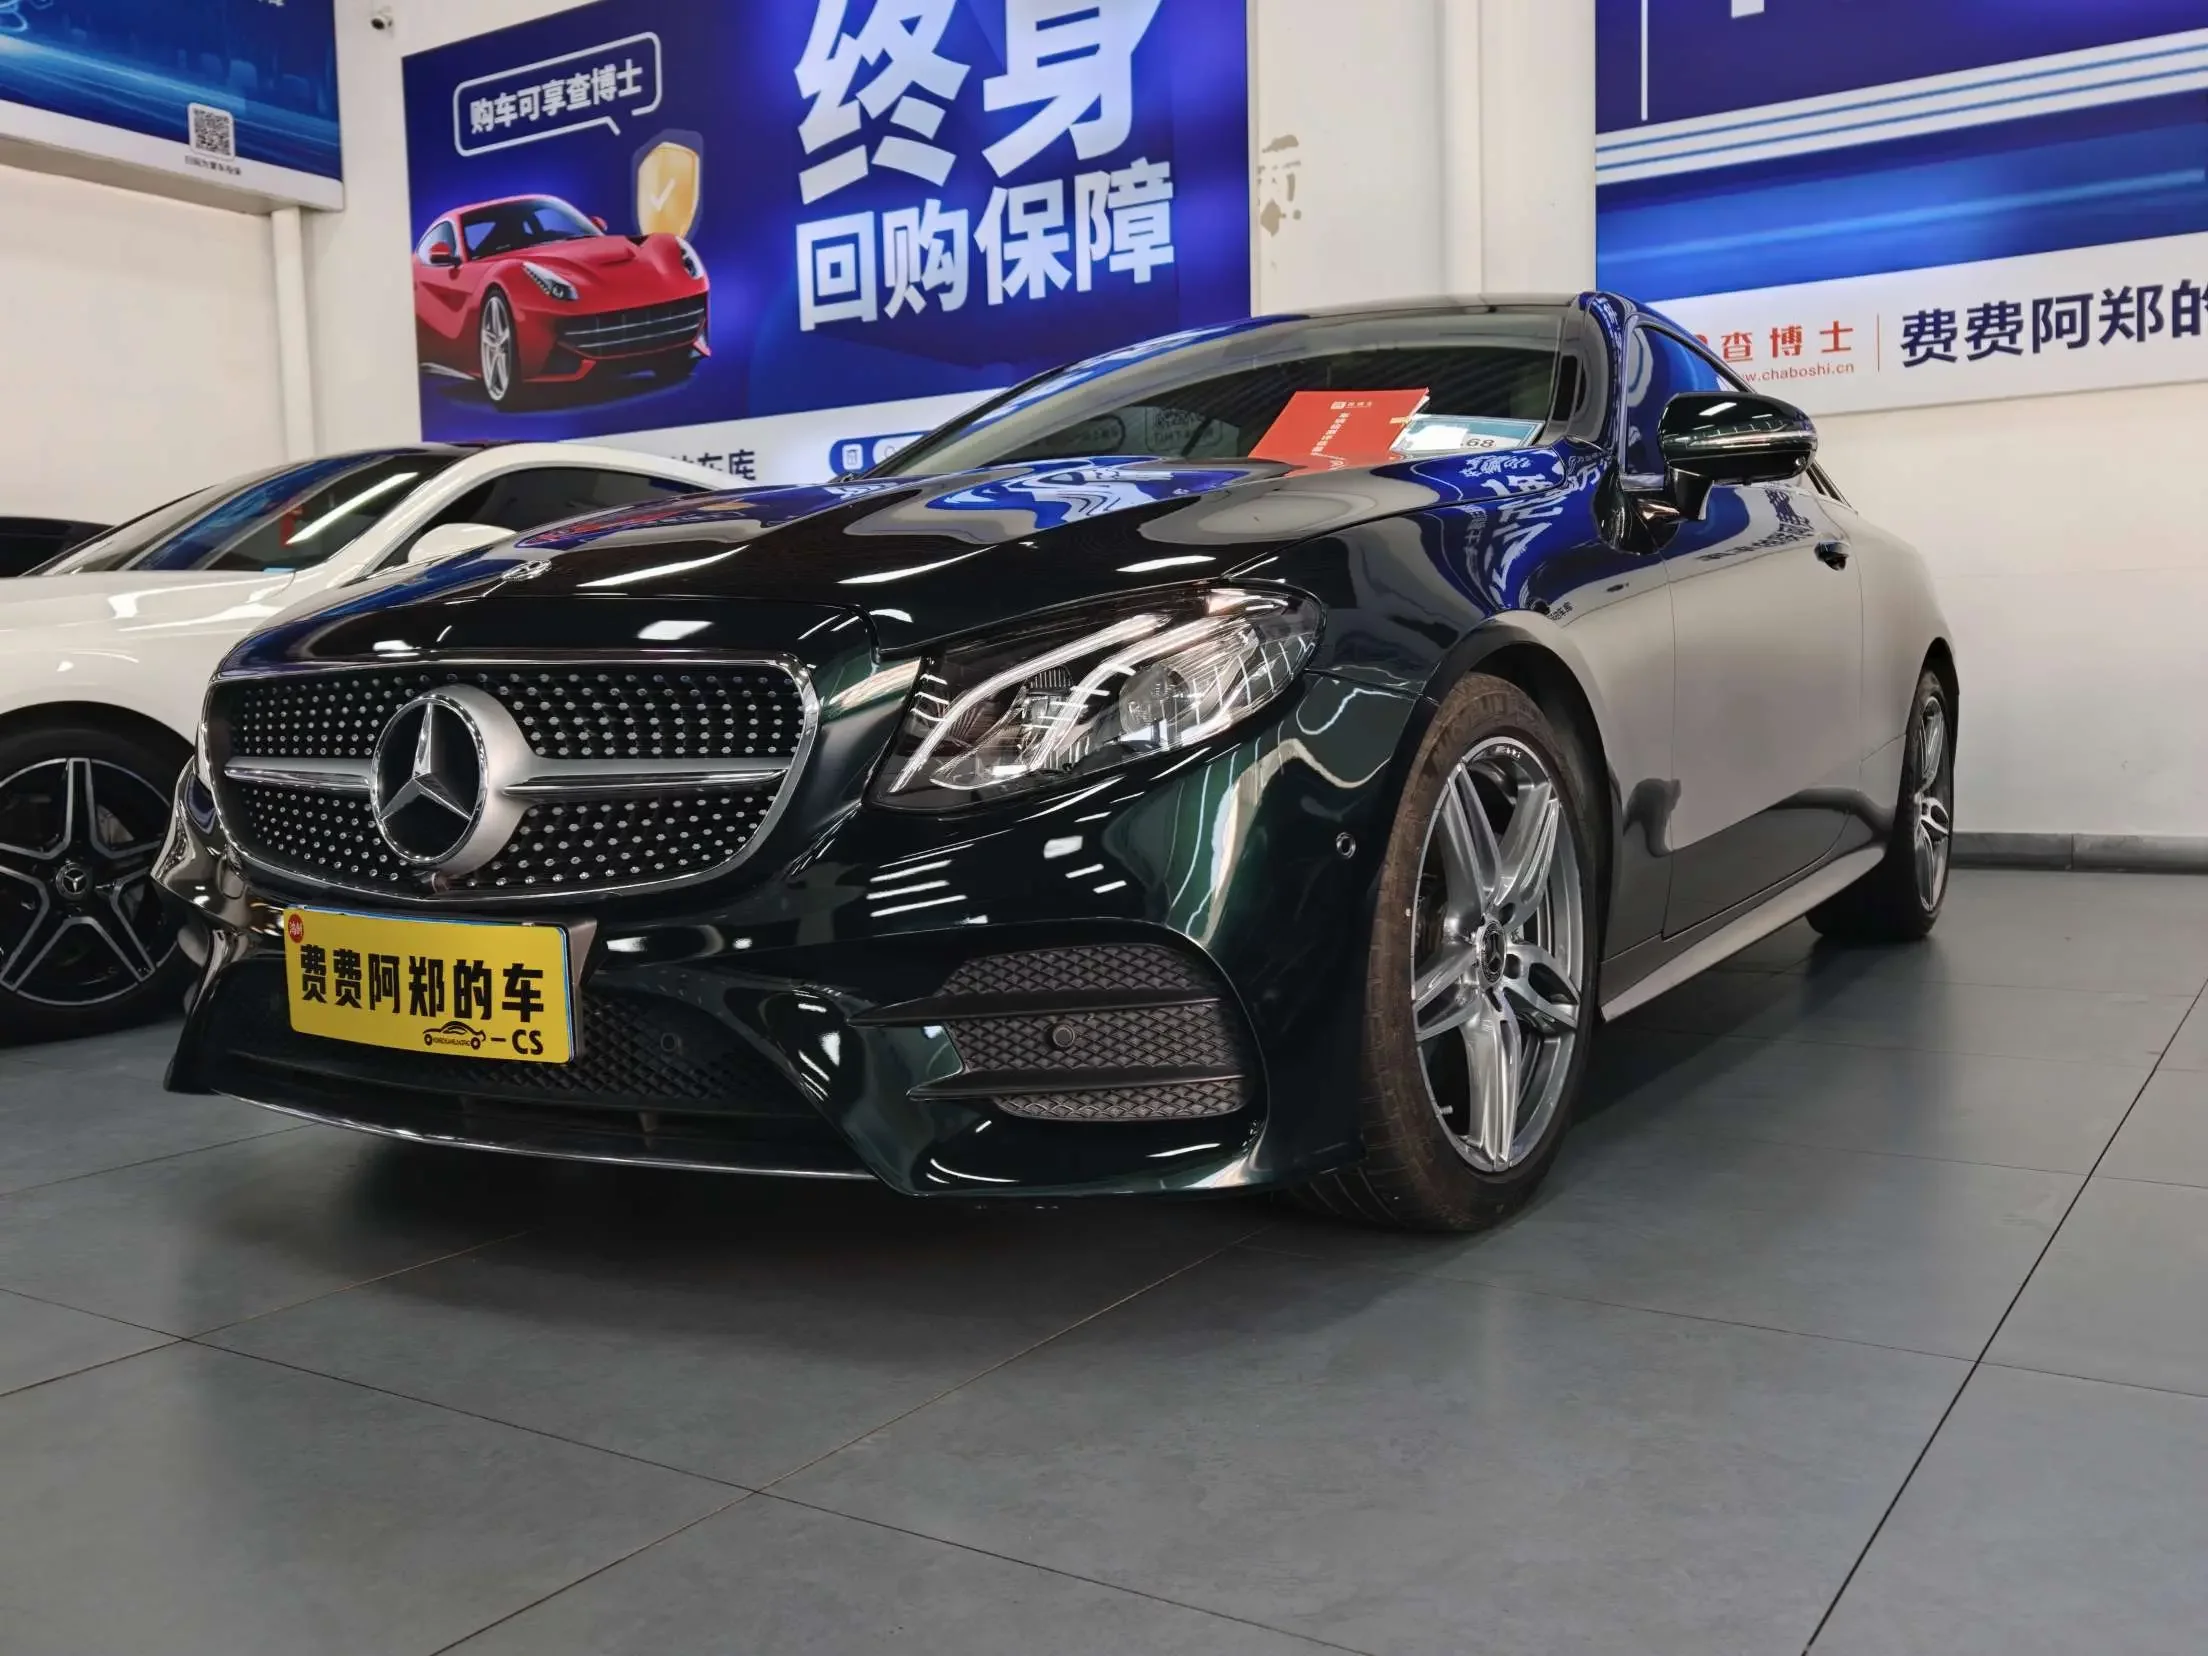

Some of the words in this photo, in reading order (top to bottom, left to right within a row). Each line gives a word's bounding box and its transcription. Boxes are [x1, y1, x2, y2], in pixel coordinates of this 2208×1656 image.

[470, 58, 643, 134] 购车可享查博士
[794, 0, 1162, 205] 终身
[796, 157, 1174, 331] 回购保障
[1721, 320, 1853, 363] 查博士
[300, 944, 544, 1022] 费费阿郑的车
